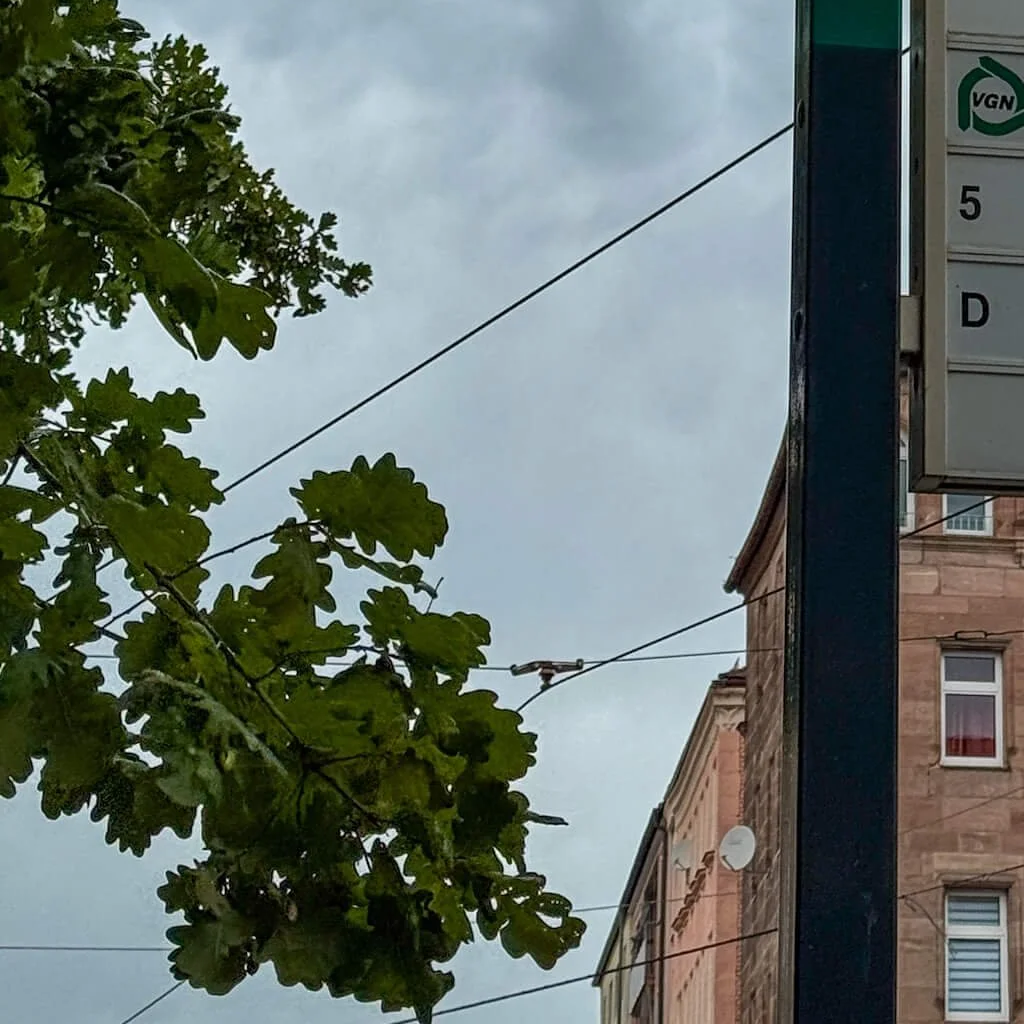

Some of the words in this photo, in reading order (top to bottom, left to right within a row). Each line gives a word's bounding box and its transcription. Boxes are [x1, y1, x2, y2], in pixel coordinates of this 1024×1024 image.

[971, 92, 1014, 111] VGN
[959, 185, 982, 221] 5
[960, 291, 990, 328] D
